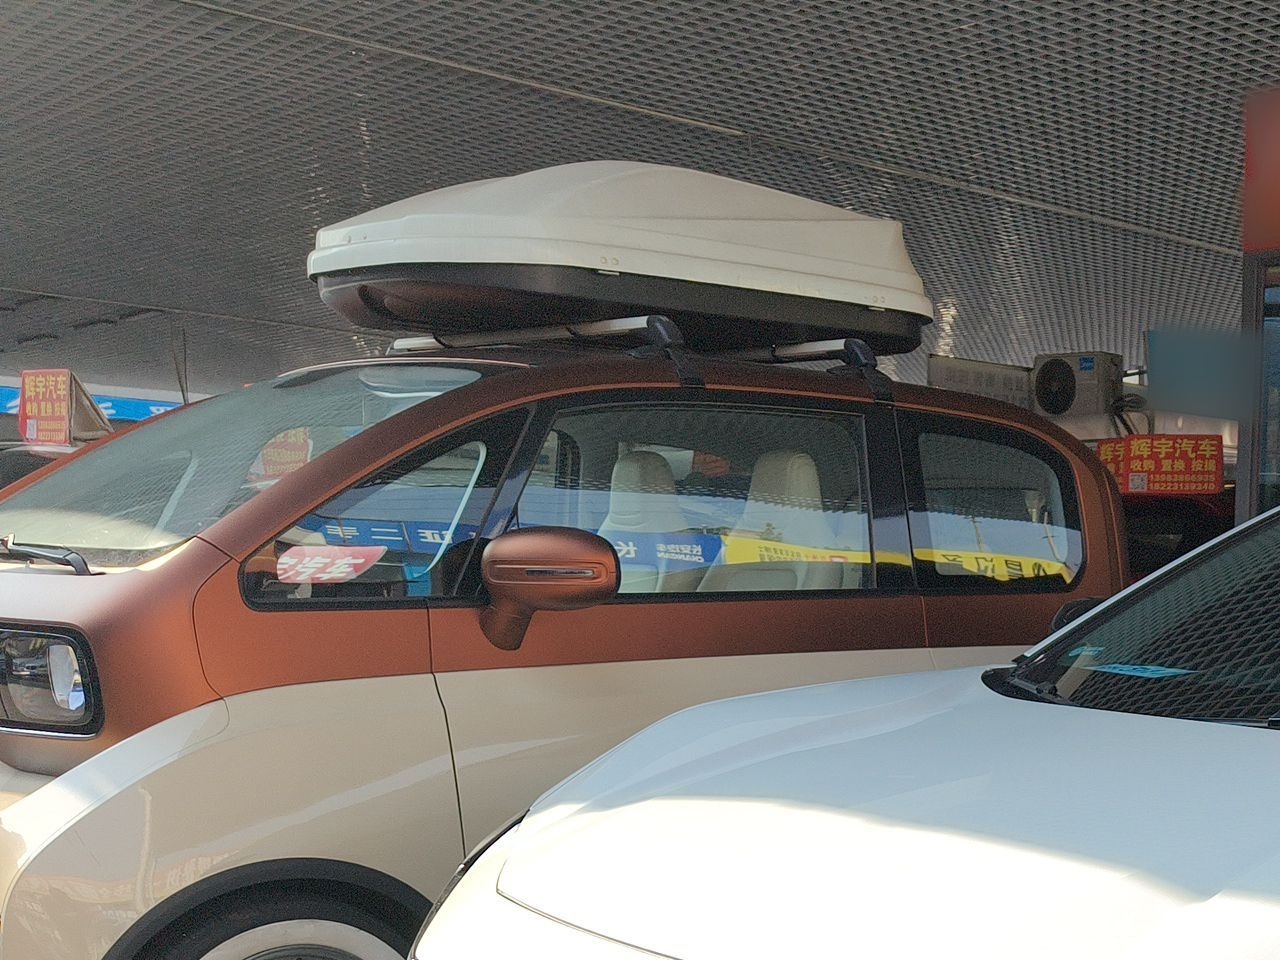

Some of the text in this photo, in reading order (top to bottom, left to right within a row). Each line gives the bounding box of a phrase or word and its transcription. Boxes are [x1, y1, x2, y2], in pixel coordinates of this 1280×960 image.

[24, 375, 67, 399] 辉宇汽车
[1130, 439, 1217, 458] 辉宇汽车
[1130, 459, 1155, 472] 收购
[1161, 459, 1185, 472] 置换
